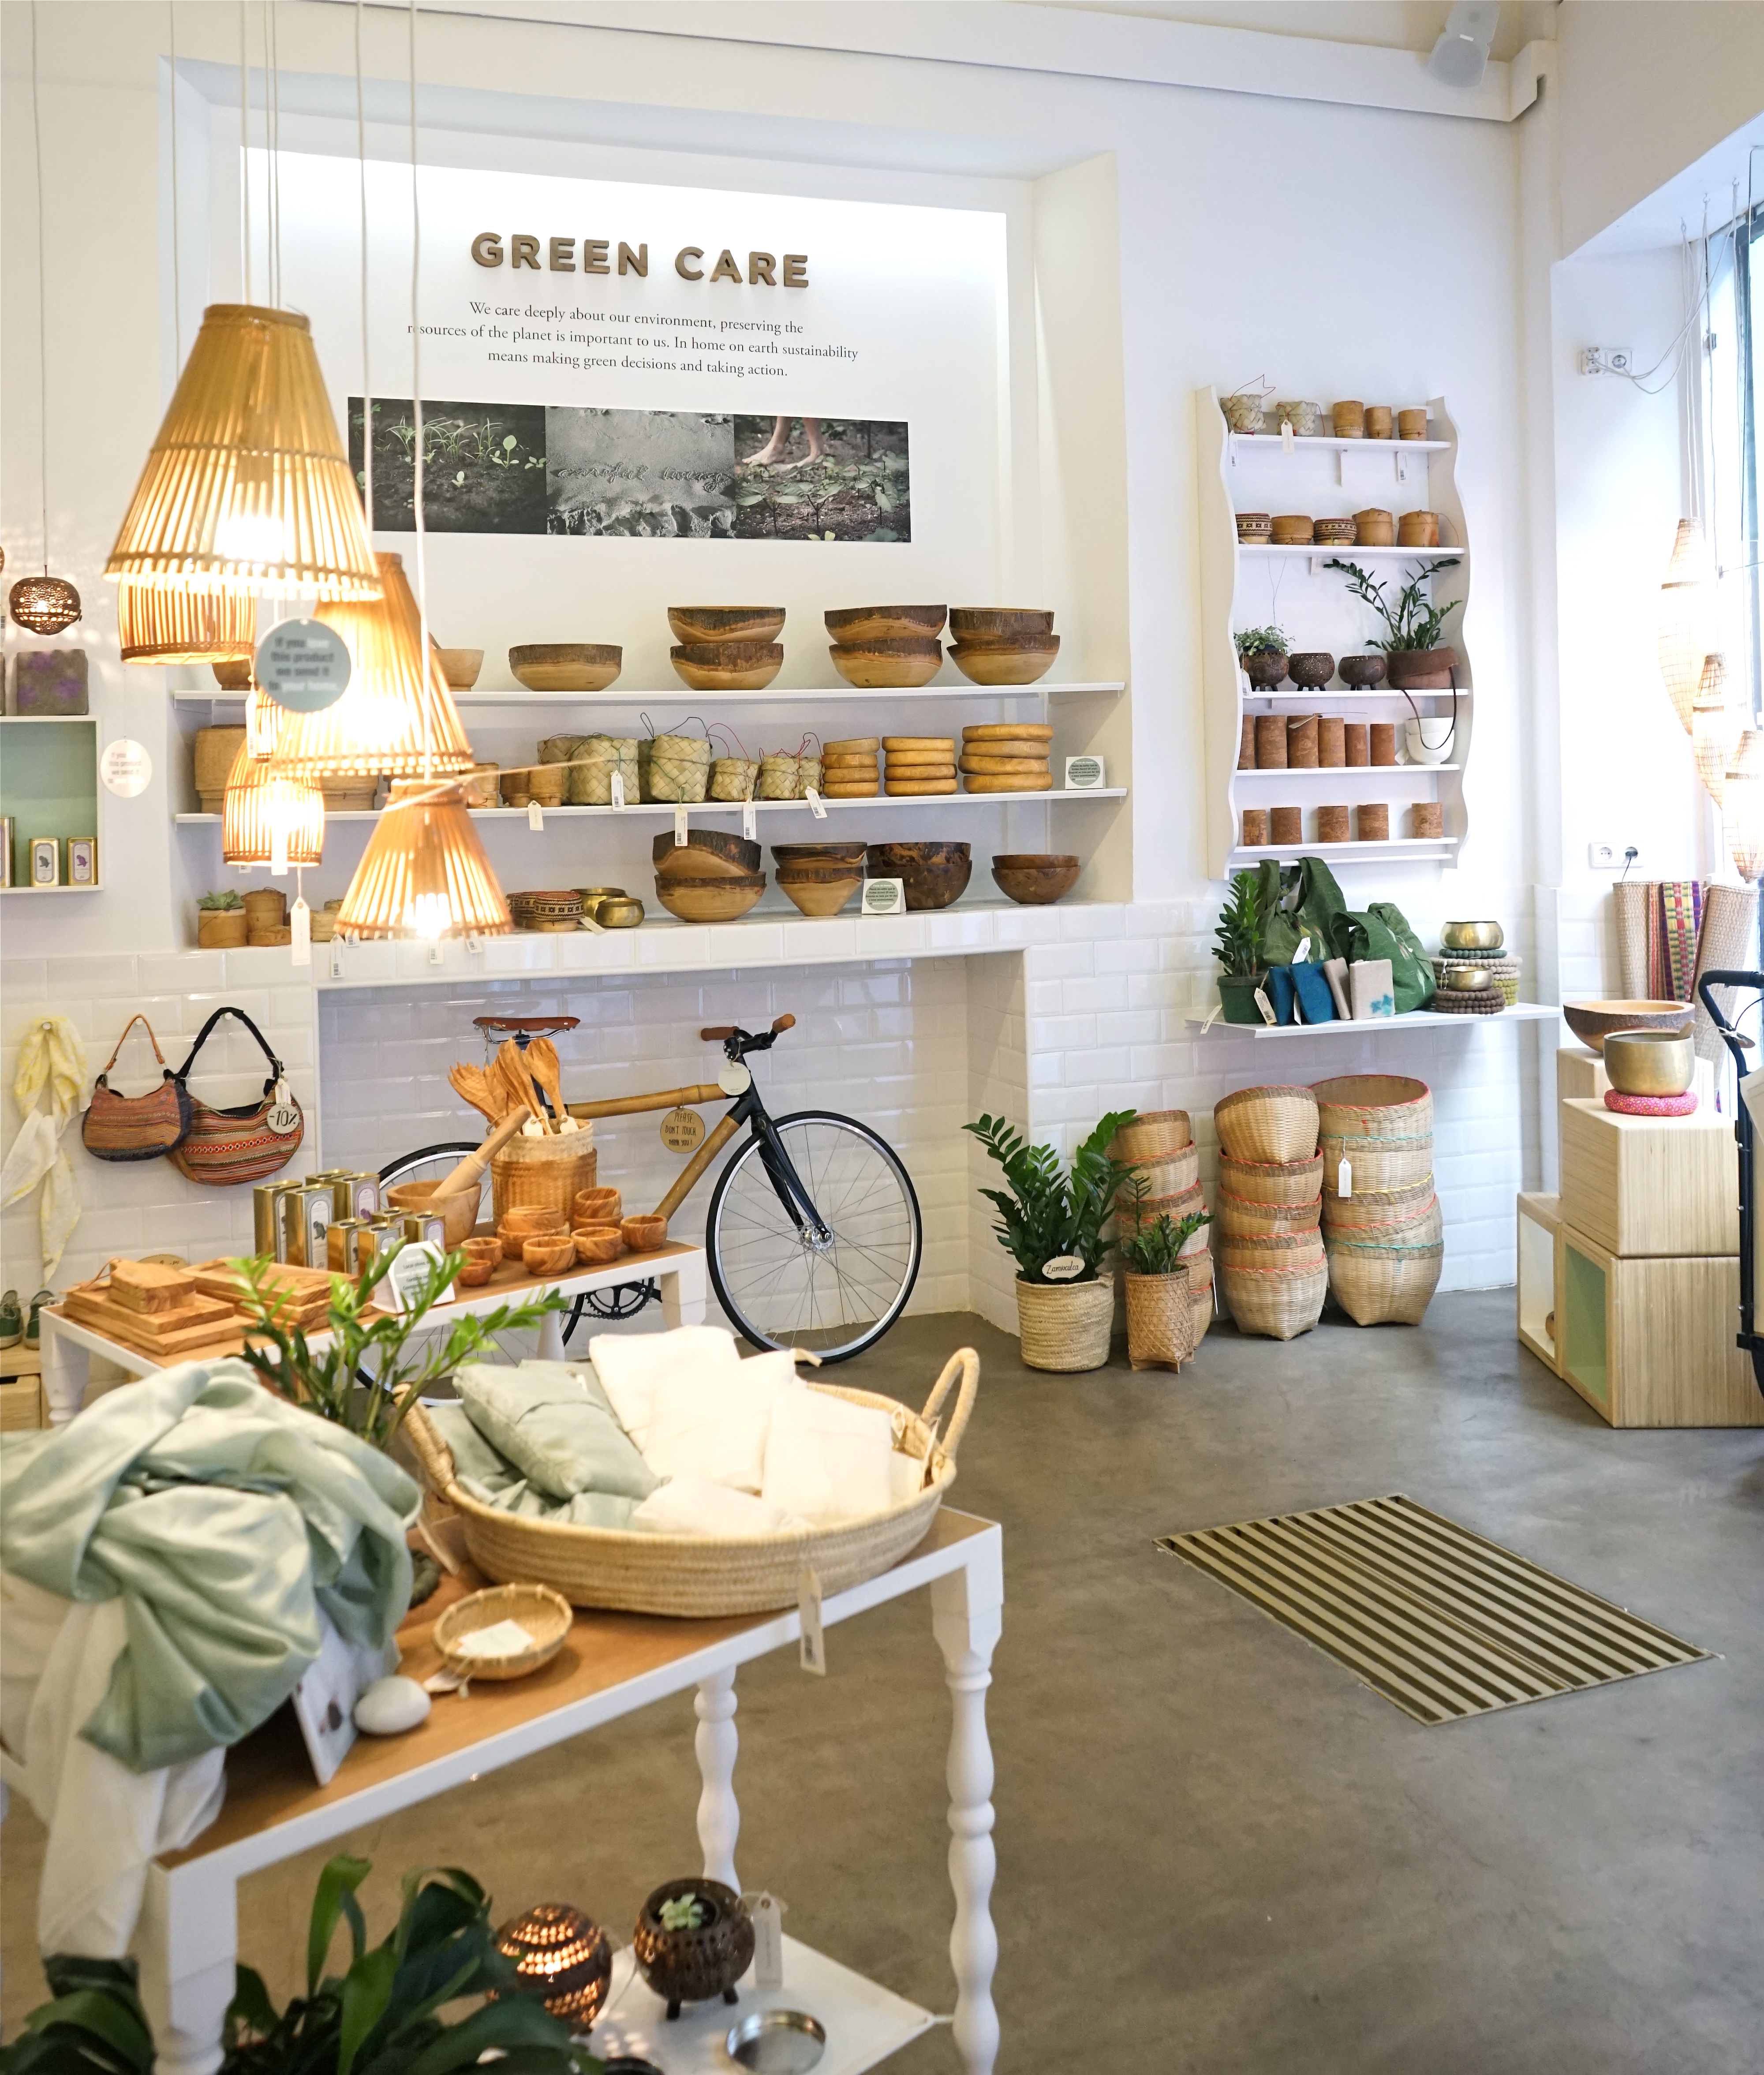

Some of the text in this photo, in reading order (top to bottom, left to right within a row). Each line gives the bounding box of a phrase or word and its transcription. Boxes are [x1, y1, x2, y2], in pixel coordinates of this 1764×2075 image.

[471, 232, 809, 288] GREEN CARE
[469, 302, 803, 336] We care deeply about our environment, preserving the
[407, 325, 466, 336] rsources
[471, 325, 486, 337] of
[489, 325, 508, 338] the
[513, 327, 552, 343] planet
[557, 330, 565, 341] is
[570, 334, 633, 347] important
[637, 337, 649, 346] to
[674, 336, 687, 348] In
[692, 337, 725, 351] home
[729, 344, 744, 352] on
[748, 342, 778, 354] earth
[783, 345, 858, 362] sustainability
[488, 351, 788, 378] means making green decisions and taking action.
[269, 1110, 297, 1126] -10%
[682, 1126, 696, 1136] TOUCH
[1046, 1261, 1079, 1275] Zamioculca
